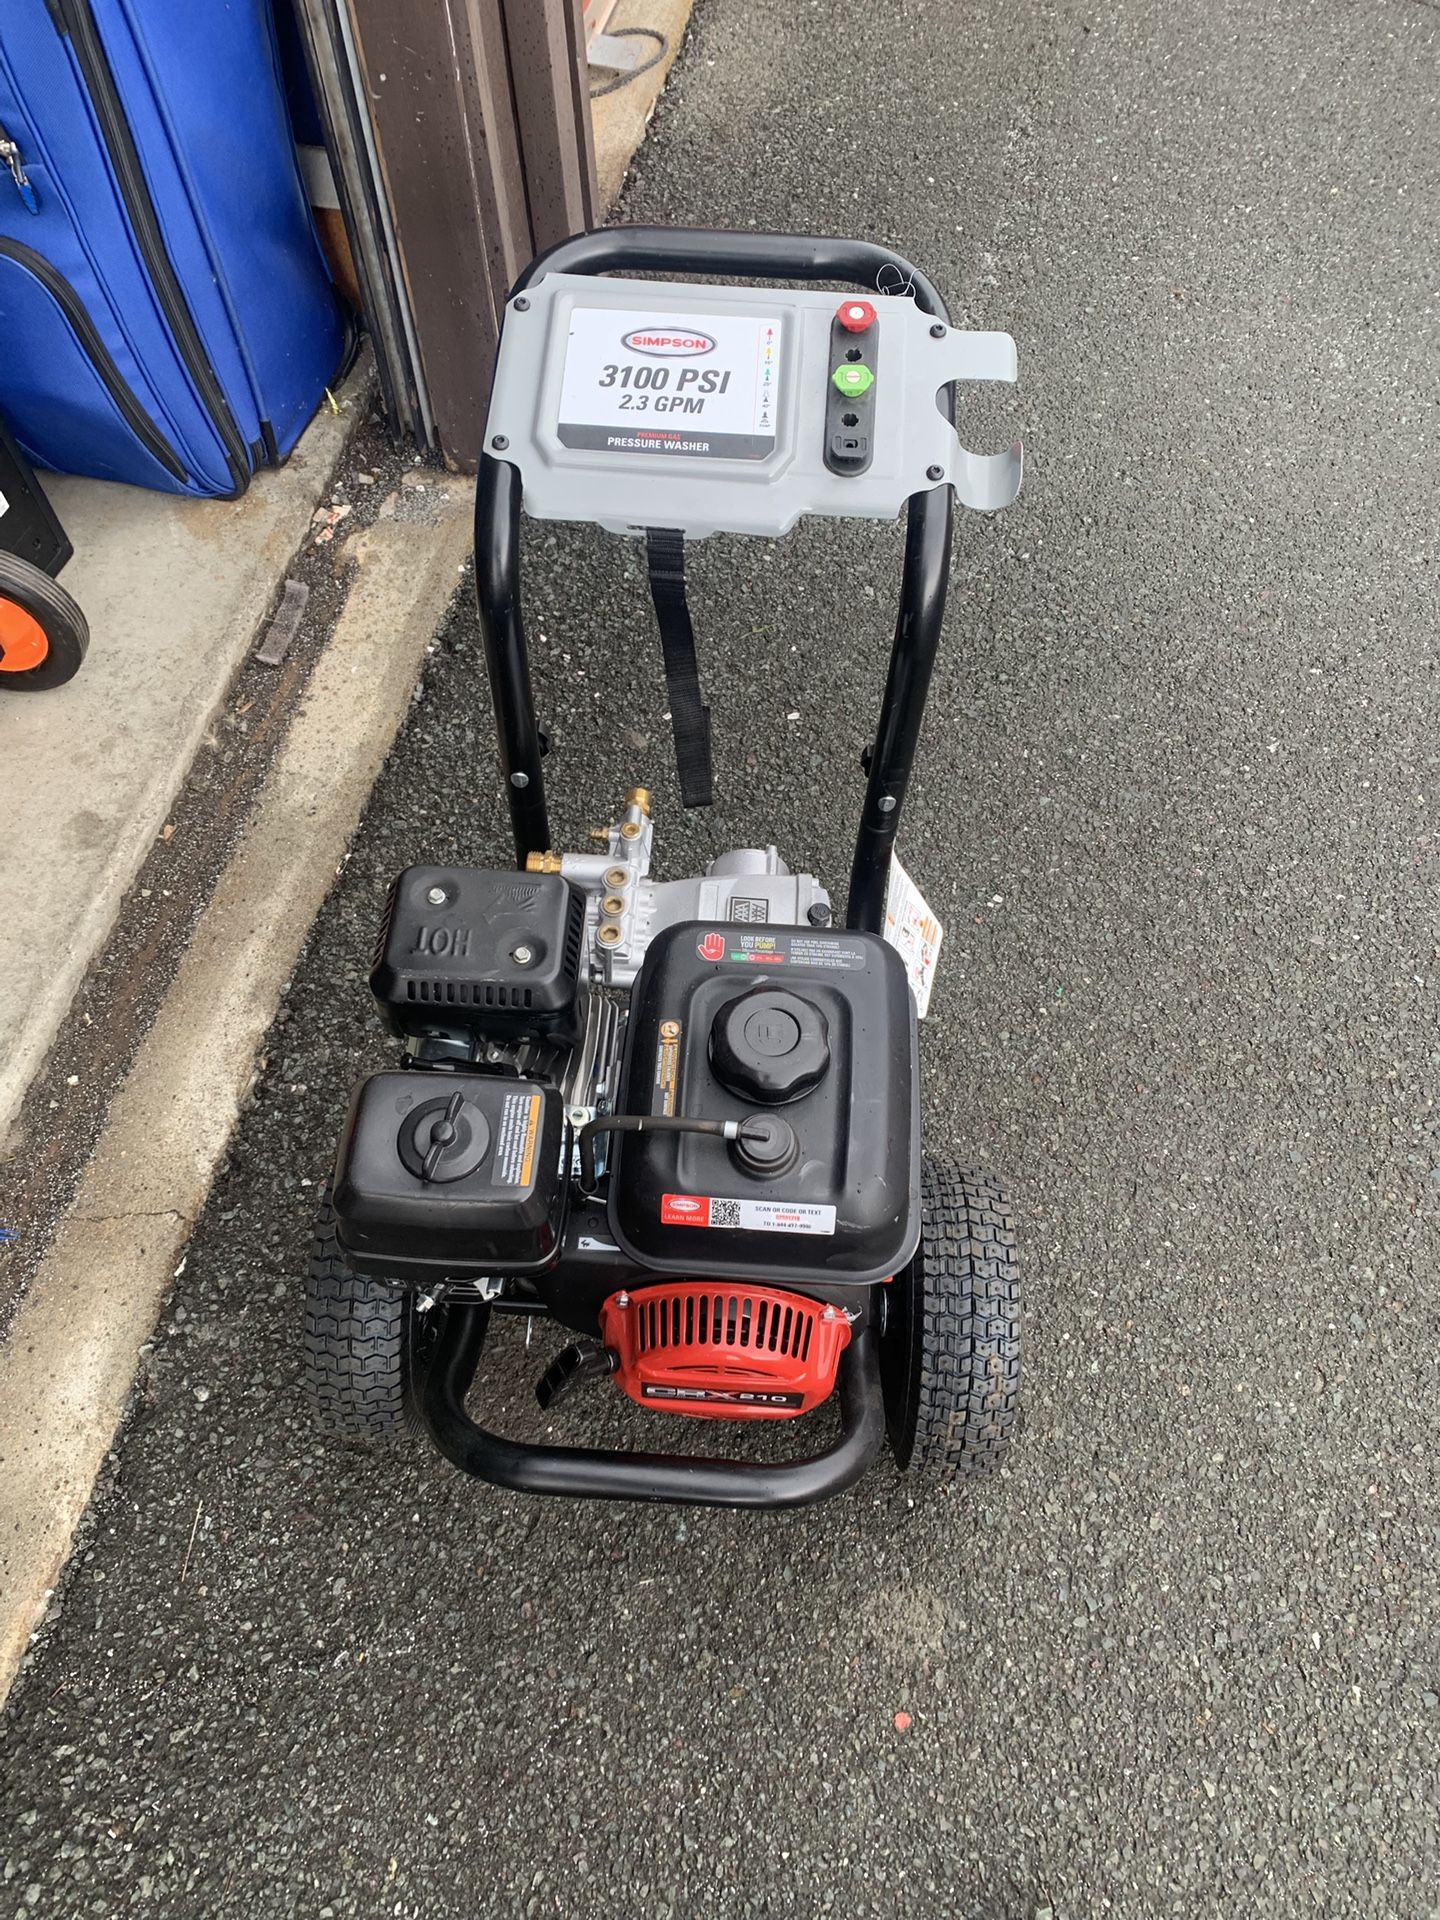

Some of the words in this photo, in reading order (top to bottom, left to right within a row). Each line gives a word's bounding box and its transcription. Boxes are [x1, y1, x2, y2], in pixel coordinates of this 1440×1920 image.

[632, 336, 707, 349] SIMPSON
[598, 364, 670, 391] 3100
[676, 368, 732, 394] PSI
[618, 394, 648, 411] 2.3
[654, 396, 705, 414] GPM
[607, 437, 662, 450] PRESSURE
[664, 440, 710, 452] WASHER
[636, 431, 667, 440] PREMIUM
[668, 432, 681, 441] GAS
[409, 926, 472, 956] HOT
[524, 1128, 534, 1162] WARNING
